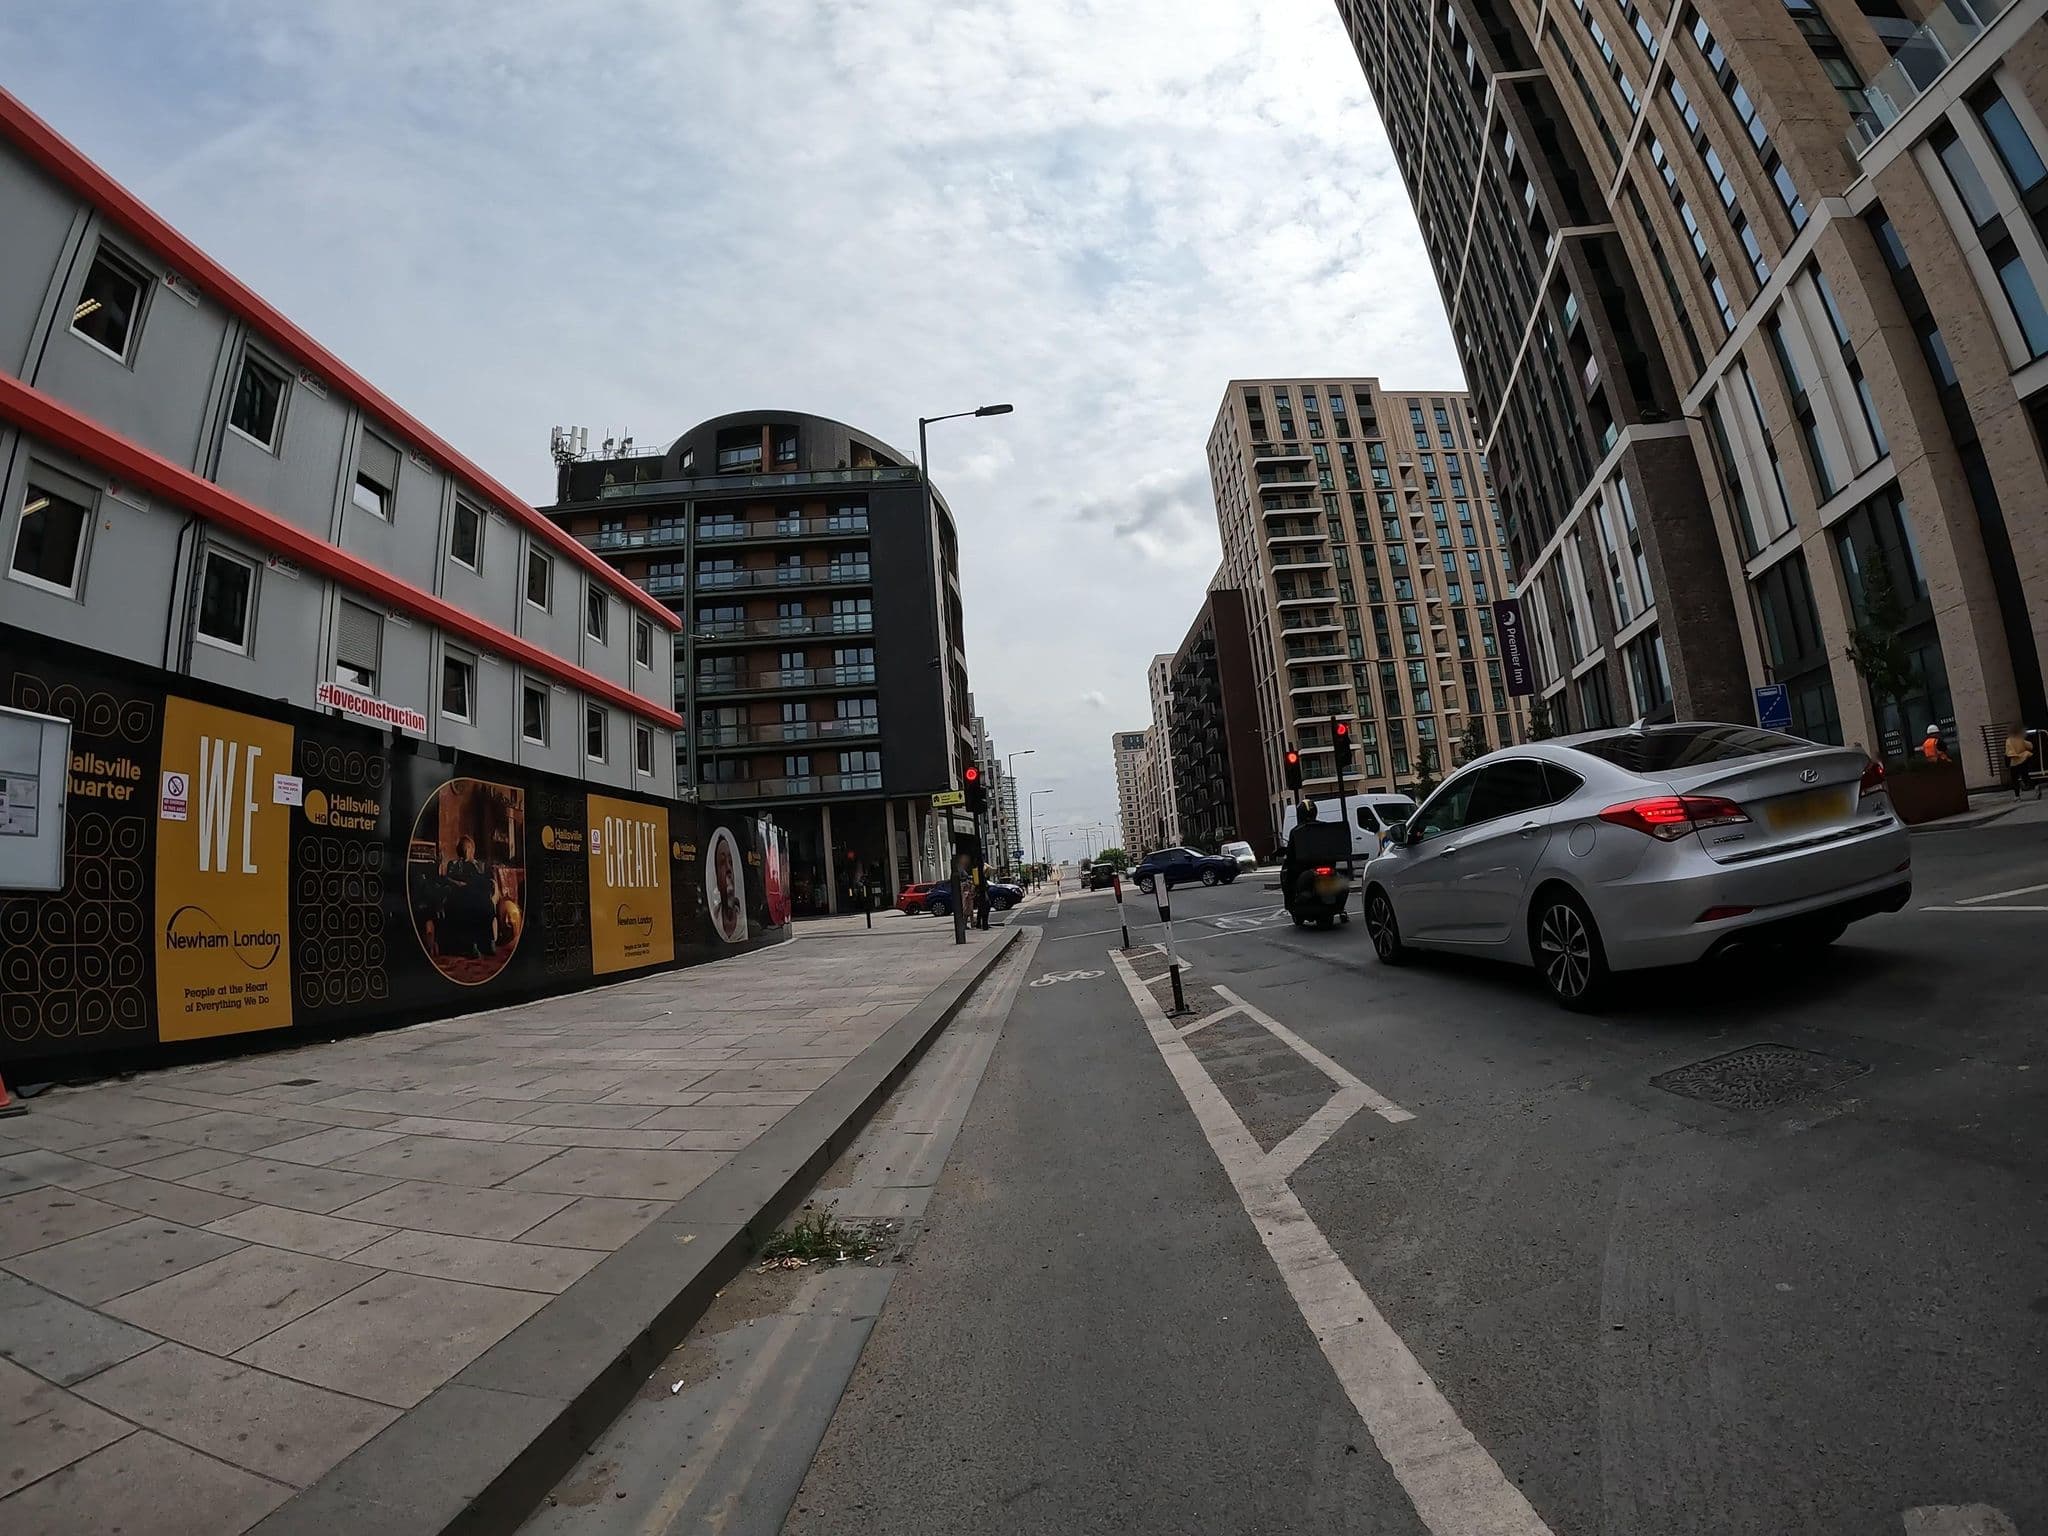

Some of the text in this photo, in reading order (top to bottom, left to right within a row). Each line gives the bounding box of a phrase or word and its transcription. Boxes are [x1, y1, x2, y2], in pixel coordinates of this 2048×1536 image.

[1507, 627, 1524, 685] Premier Inn
[319, 684, 425, 732] #loveconstruction
[199, 735, 262, 874] WE
[330, 793, 380, 815] Hallsville
[330, 810, 377, 831] Quarter
[605, 816, 659, 888] CREATE
[166, 929, 281, 950] Newham London
[184, 981, 268, 999] People at the Heart
[185, 995, 270, 1013] of Everything We Do
